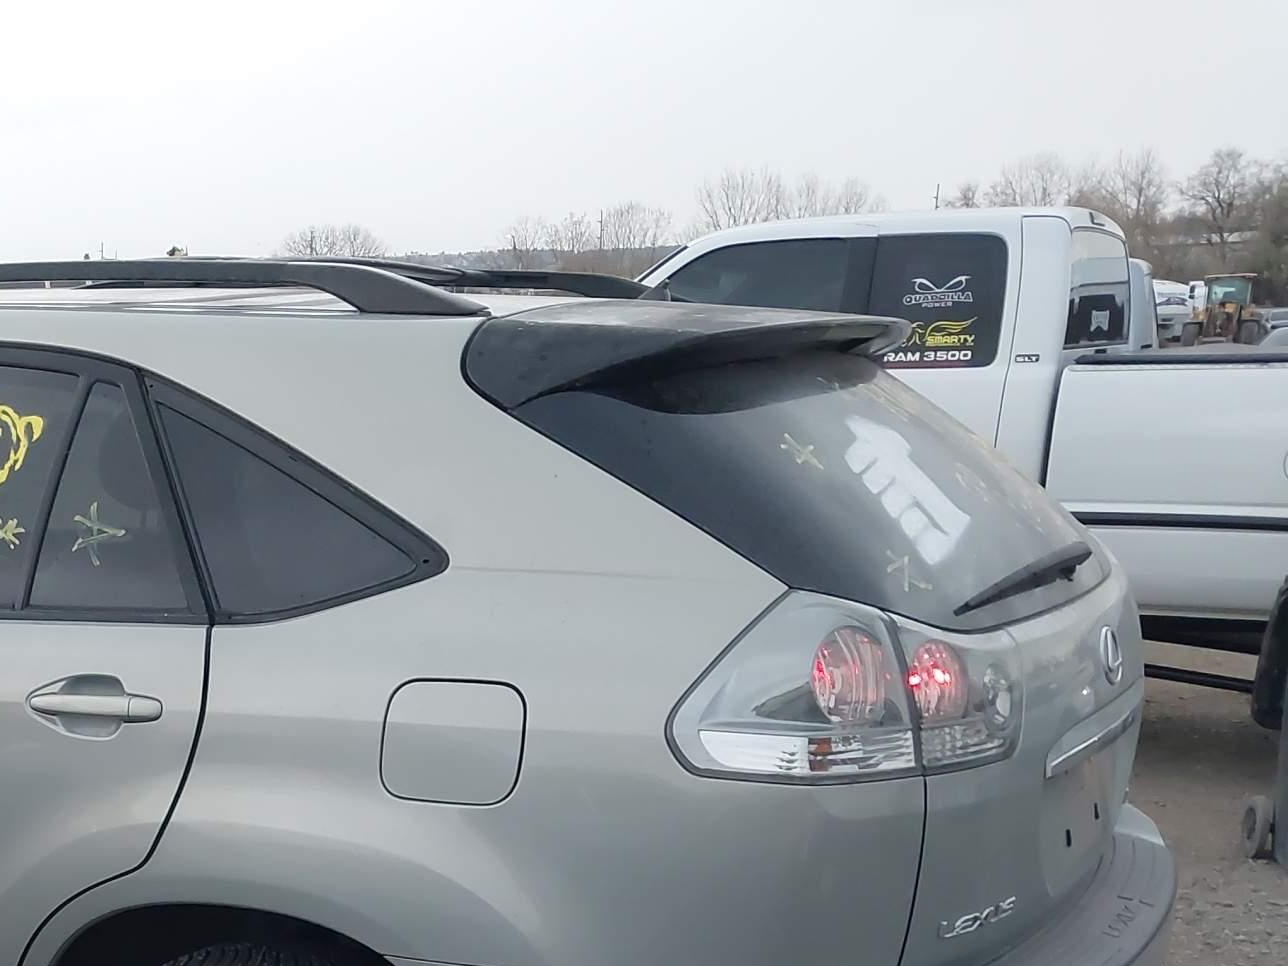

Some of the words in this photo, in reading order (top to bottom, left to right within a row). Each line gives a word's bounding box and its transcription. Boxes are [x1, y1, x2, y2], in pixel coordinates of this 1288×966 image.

[926, 334, 975, 344] SMARTY
[883, 351, 920, 362] RAM
[923, 350, 972, 362] 3500
